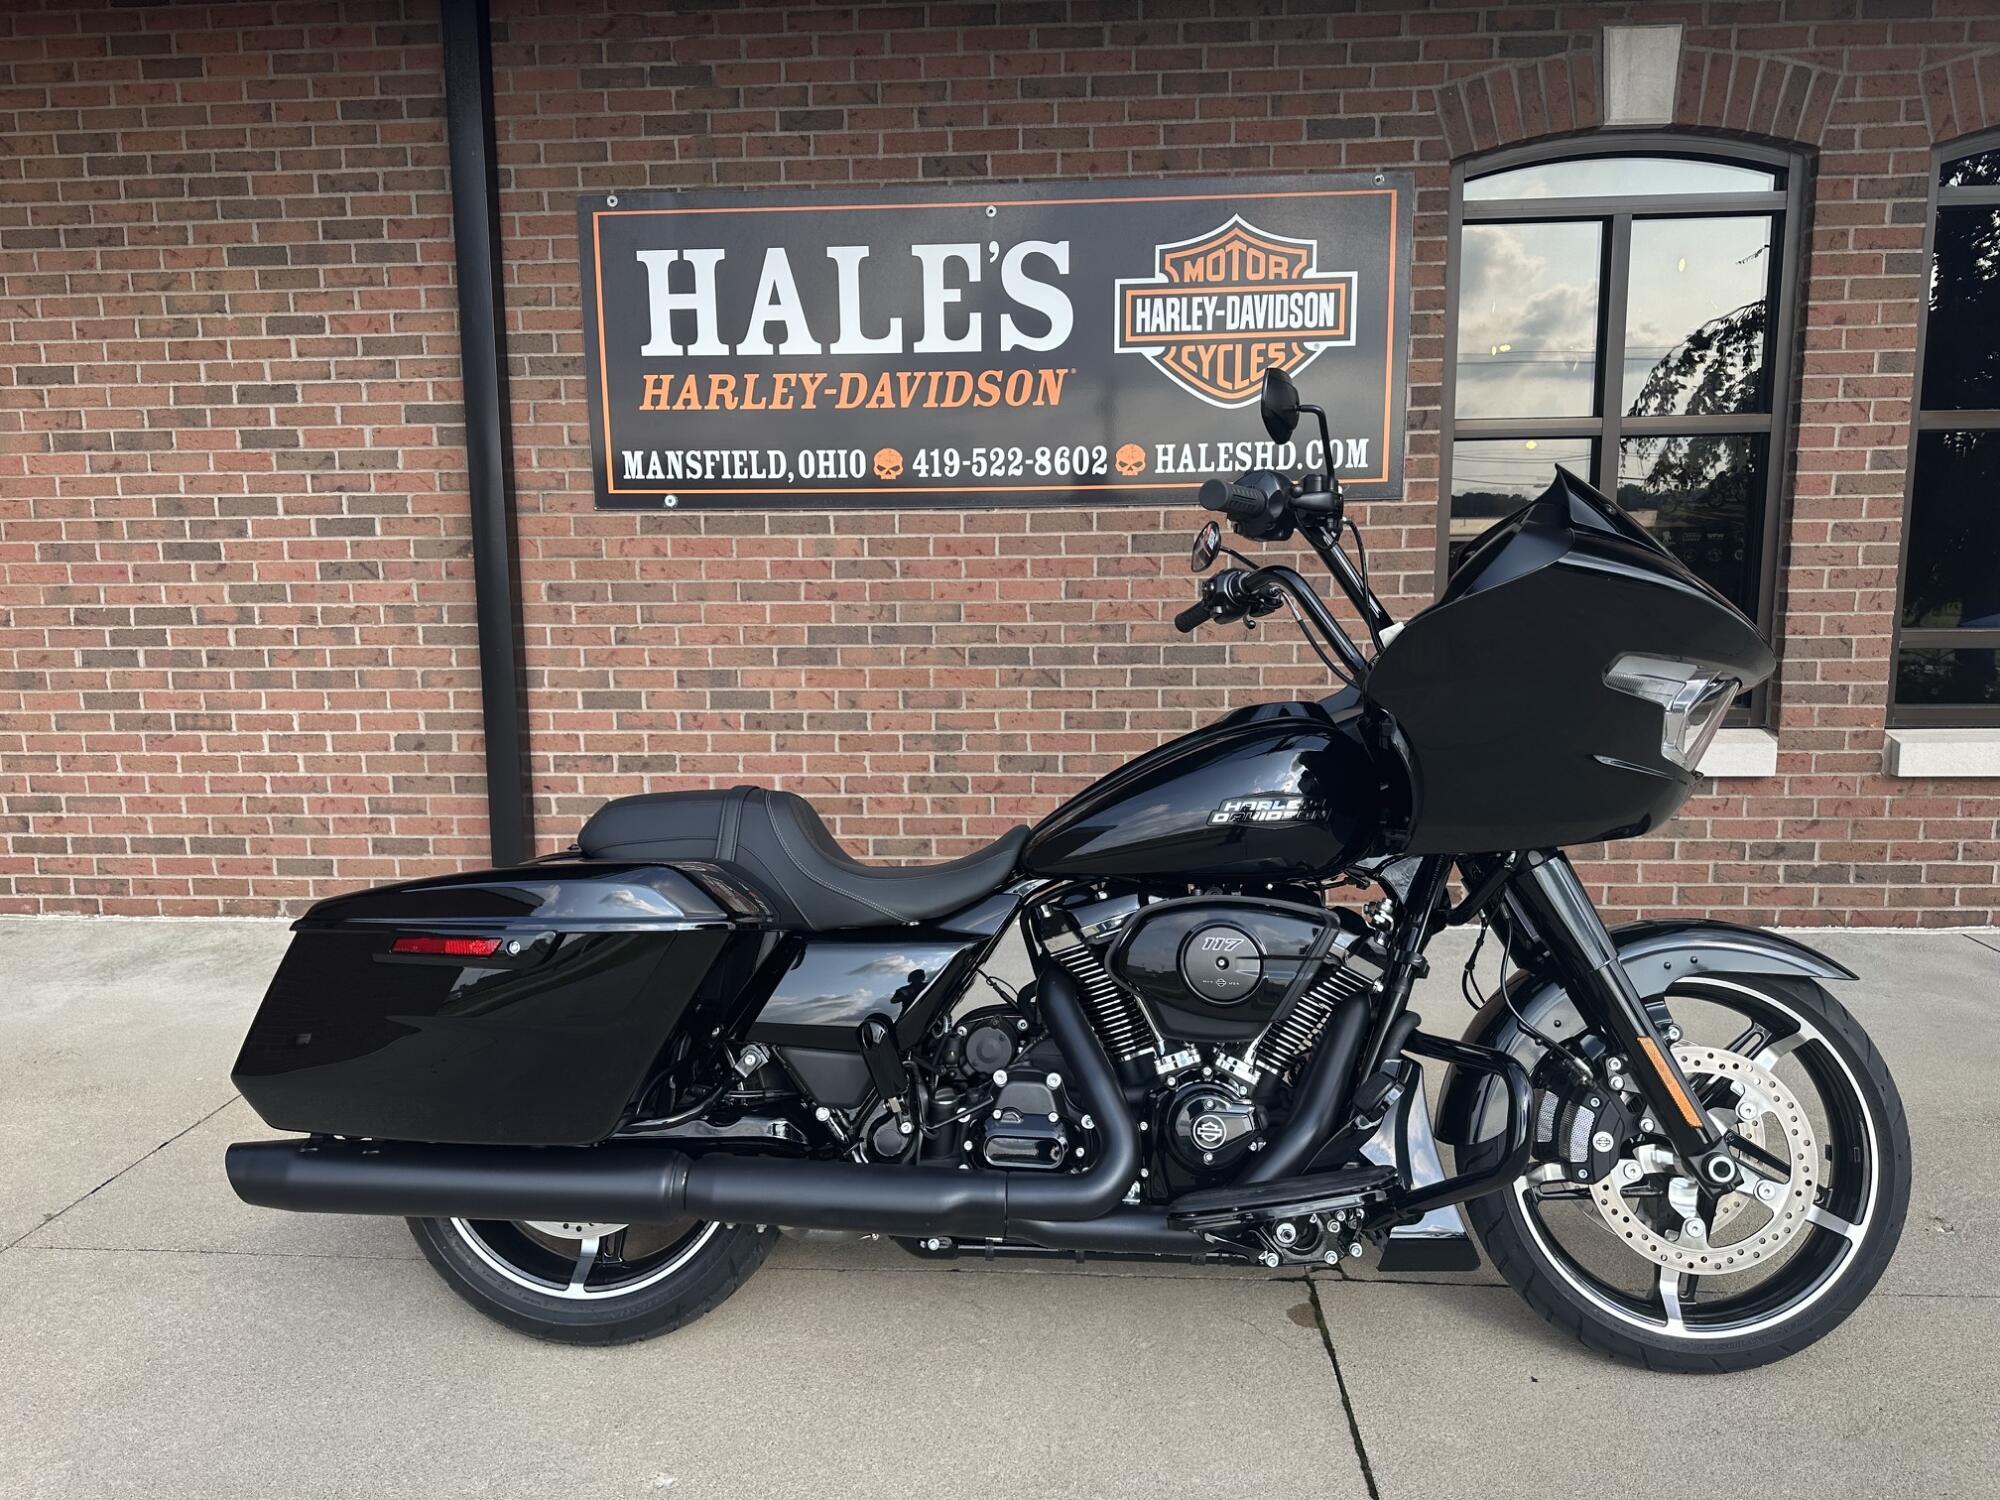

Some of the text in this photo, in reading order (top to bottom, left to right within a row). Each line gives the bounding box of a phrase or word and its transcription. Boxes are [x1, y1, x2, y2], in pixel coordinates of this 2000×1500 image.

[1183, 240, 1289, 283] MOTOR
[636, 240, 1074, 357] HALE'S
[1135, 292, 1335, 333] HARLEY-DAVIDSON
[1181, 342, 1286, 390] CYCLES
[638, 368, 1067, 411] HARLEY-DAVIDSON
[912, 445, 1108, 479] 419-522-8602
[1154, 438, 1370, 474] HALESHD.COM
[1223, 799, 1327, 812] HARLE
[1201, 936, 1245, 952] 117
